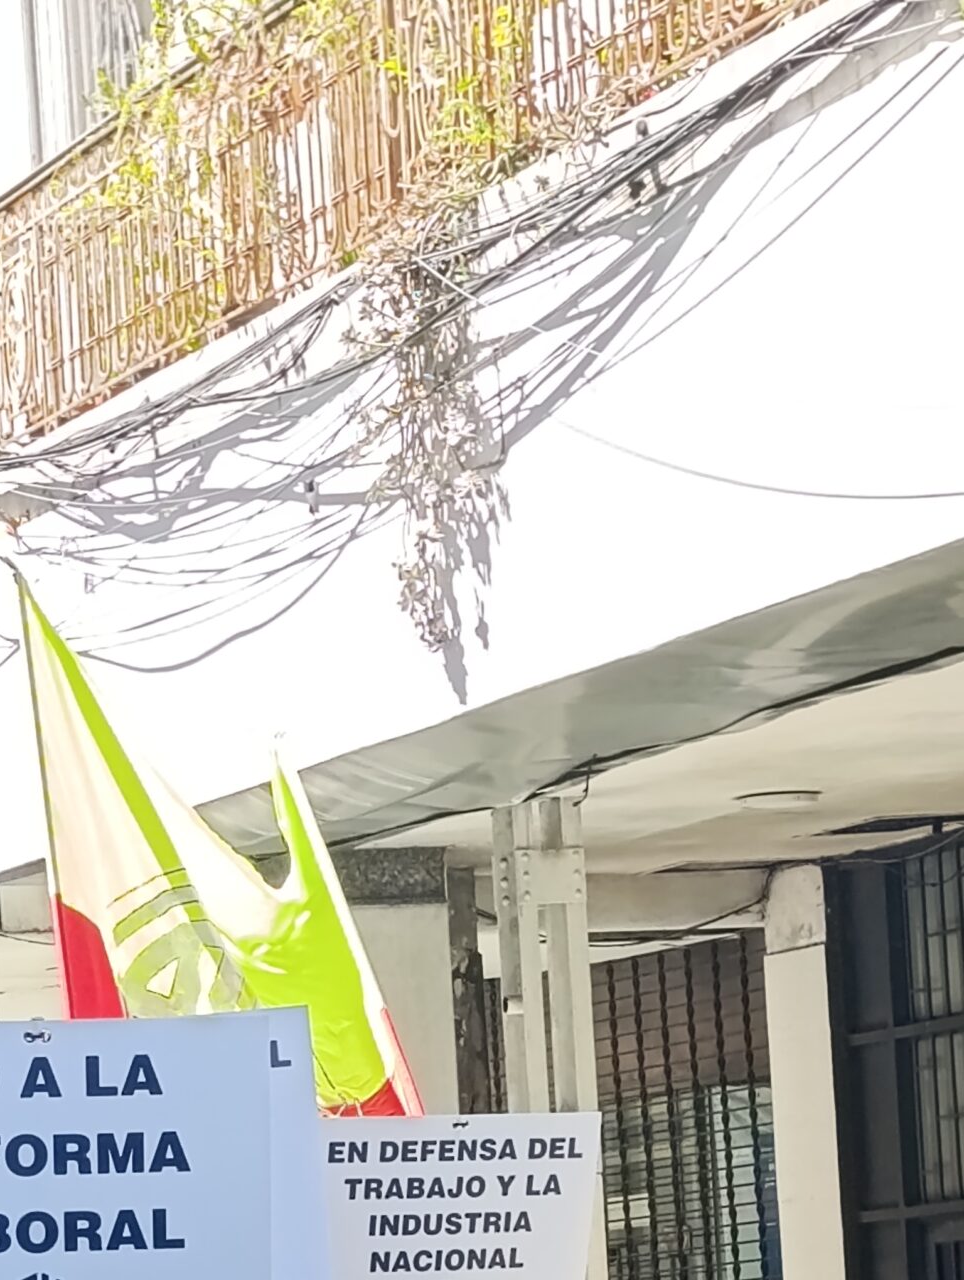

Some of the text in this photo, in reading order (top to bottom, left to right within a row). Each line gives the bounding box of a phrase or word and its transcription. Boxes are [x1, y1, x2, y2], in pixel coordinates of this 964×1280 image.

[20, 1056, 62, 1098] A
[85, 1054, 163, 1096] LA
[328, 1137, 582, 1164] EN DEFENSA DEL
[344, 1172, 561, 1200] TRABAJO Y LA
[368, 1211, 532, 1236] INDUSTRIA
[369, 1248, 524, 1273] NACIONAL
